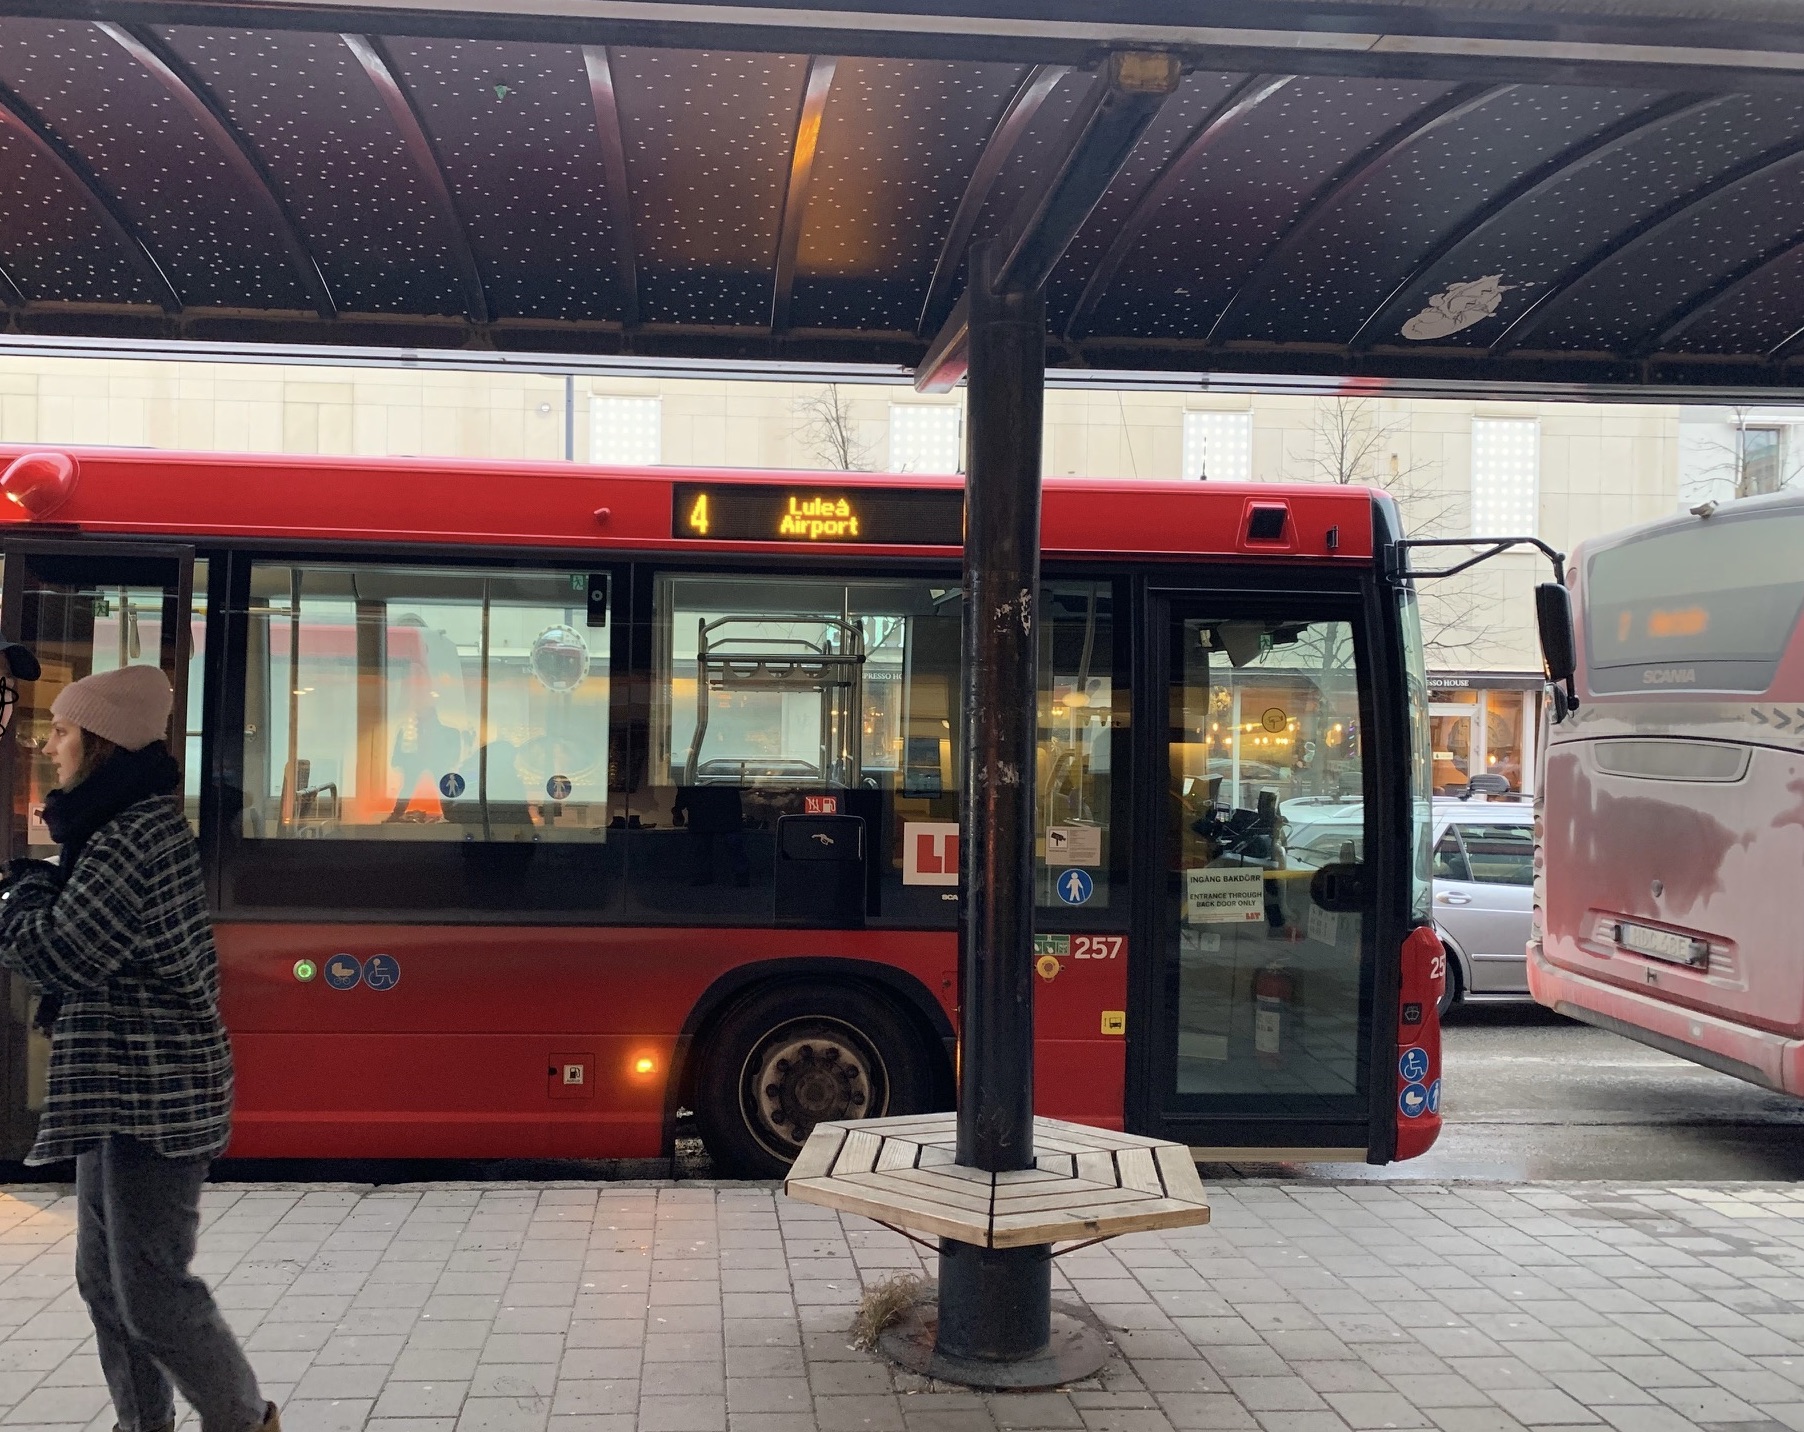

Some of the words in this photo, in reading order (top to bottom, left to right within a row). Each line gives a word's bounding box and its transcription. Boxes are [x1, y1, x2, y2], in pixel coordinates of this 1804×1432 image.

[690, 494, 709, 534] 4
[789, 497, 850, 516] Luleå
[779, 515, 859, 538] Airport
[1443, 679, 1469, 687] HOUSE
[1642, 669, 1696, 684] SCANIA
[1190, 874, 1221, 883] INGÅNG
[1223, 874, 1261, 883] BAKDÖRR
[1190, 892, 1227, 900] ENTRANCE
[1074, 937, 1123, 959] 257
